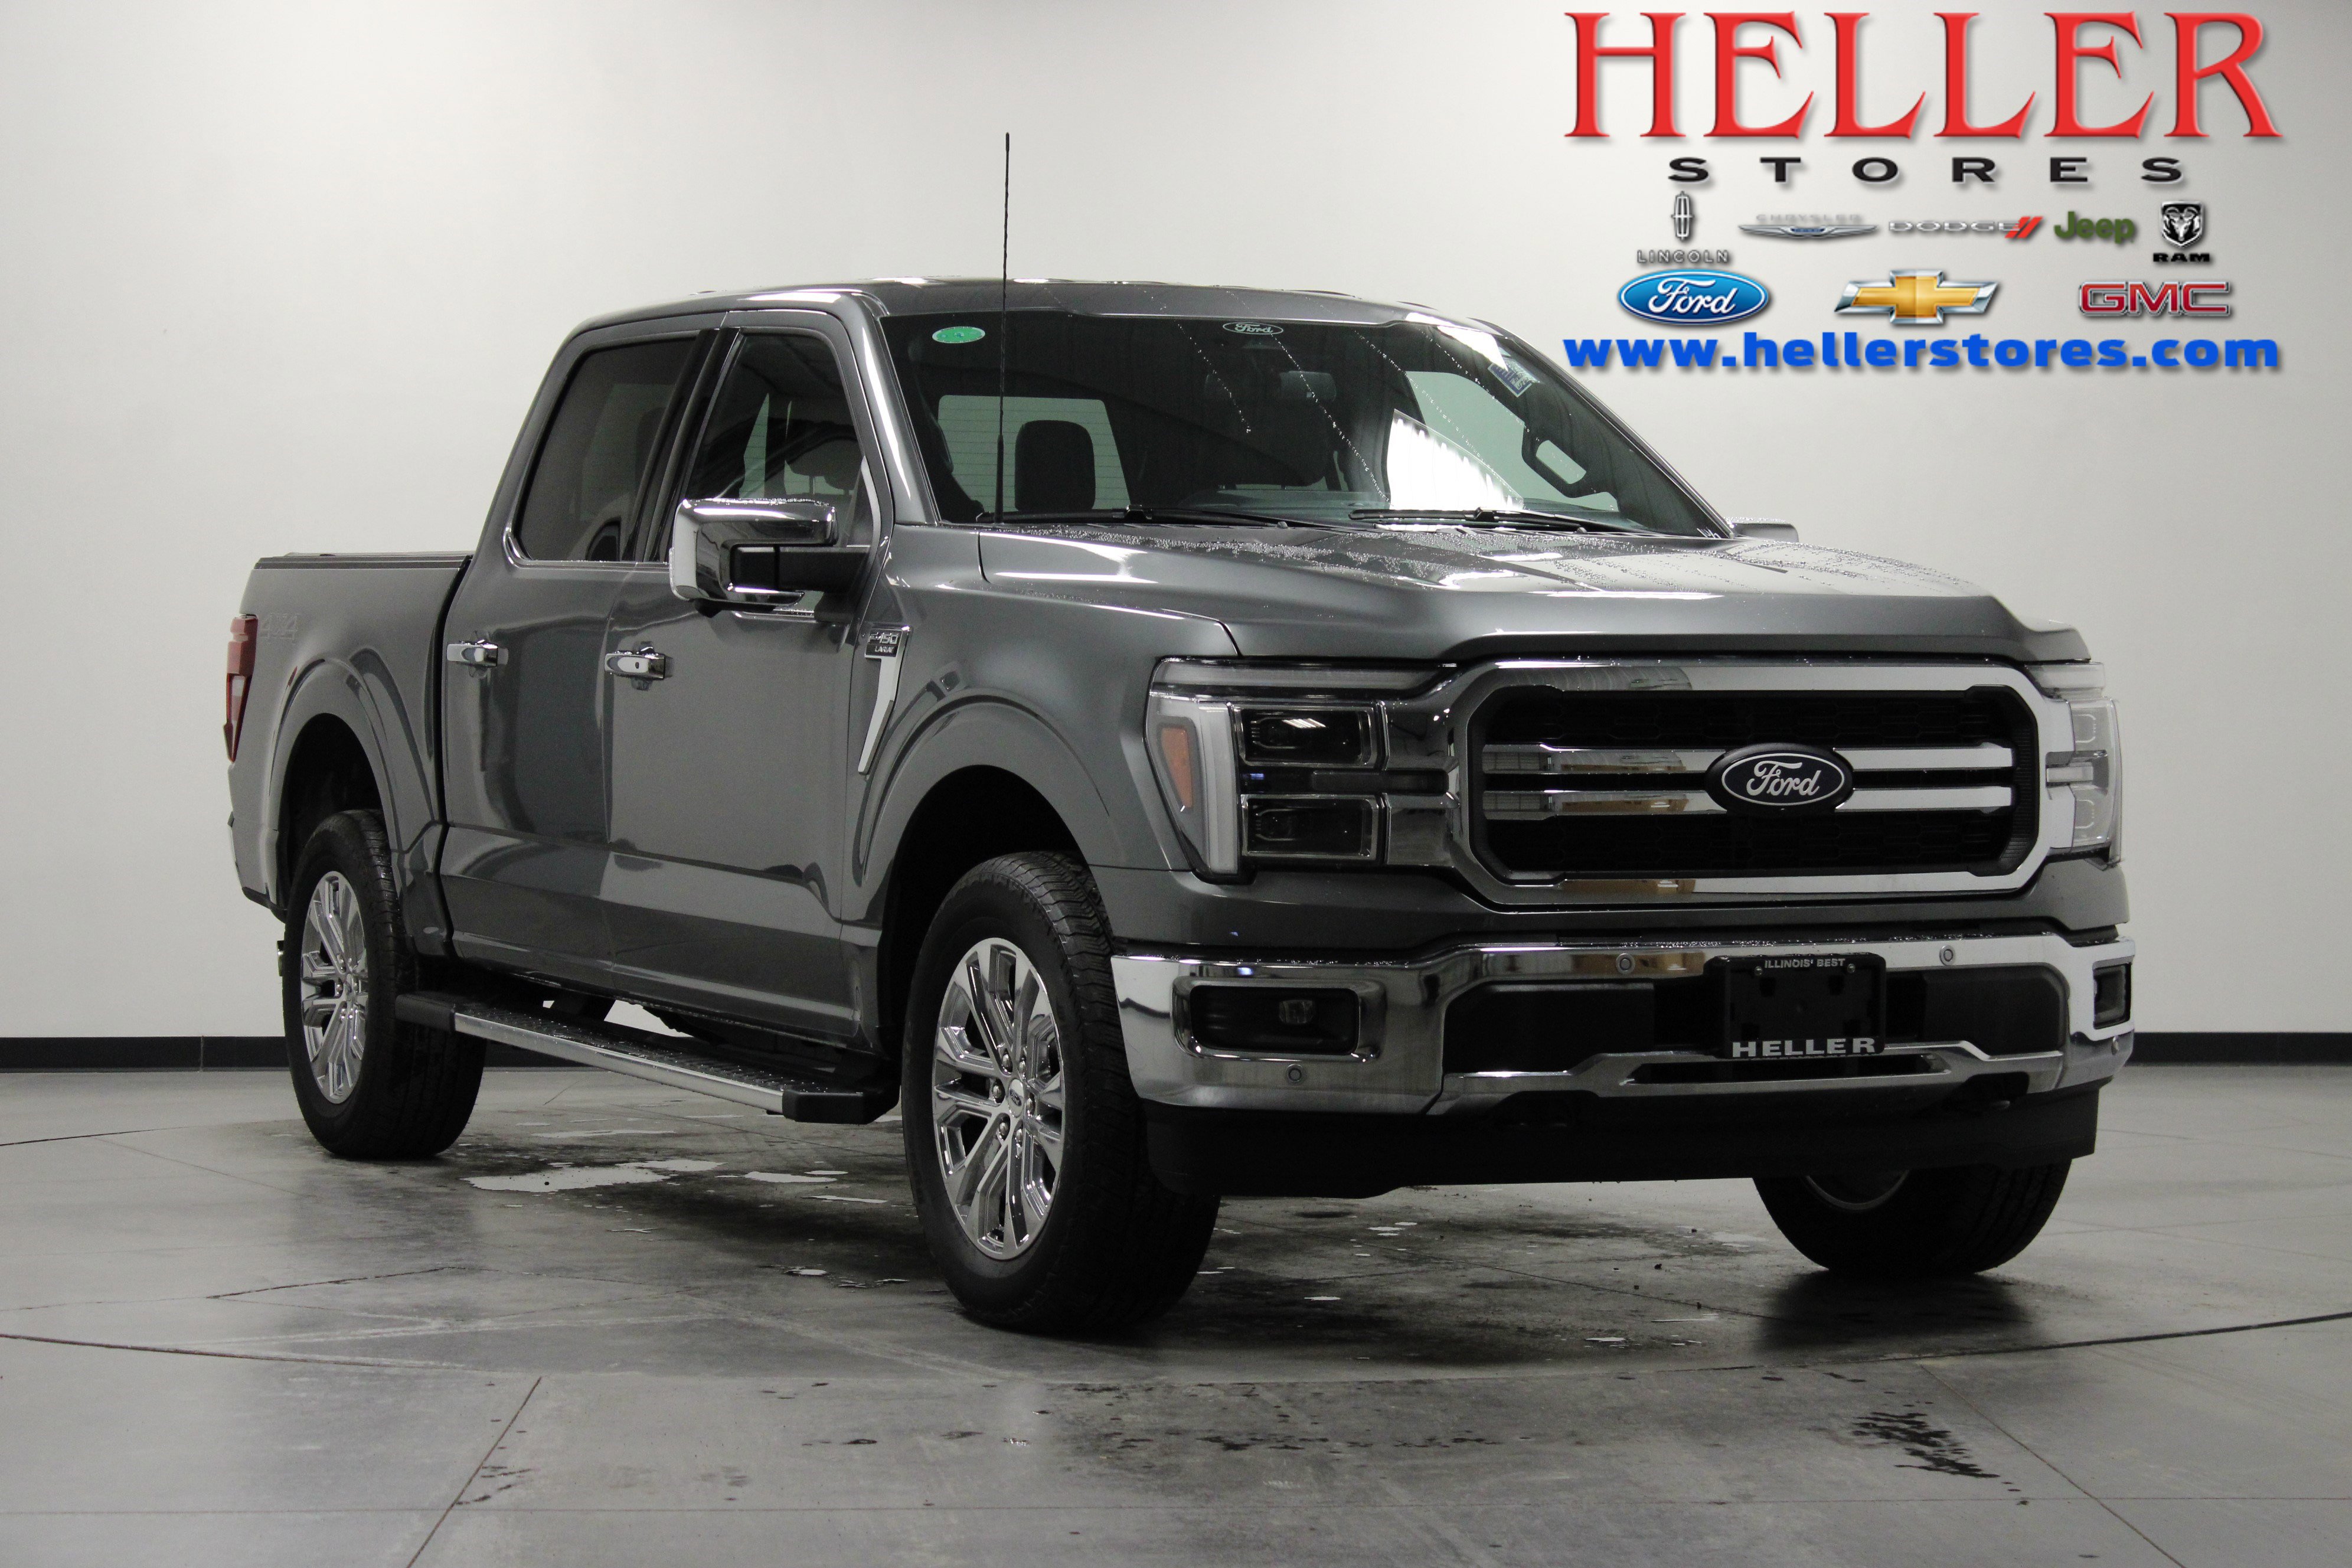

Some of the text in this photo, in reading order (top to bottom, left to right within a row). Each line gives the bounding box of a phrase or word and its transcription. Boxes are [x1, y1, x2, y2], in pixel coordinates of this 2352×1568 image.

[1234, 323, 1273, 333] Ford
[1746, 760, 1821, 796] Ford
[1817, 958, 1845, 967] BEST
[1733, 1037, 1875, 1057] HELLER
